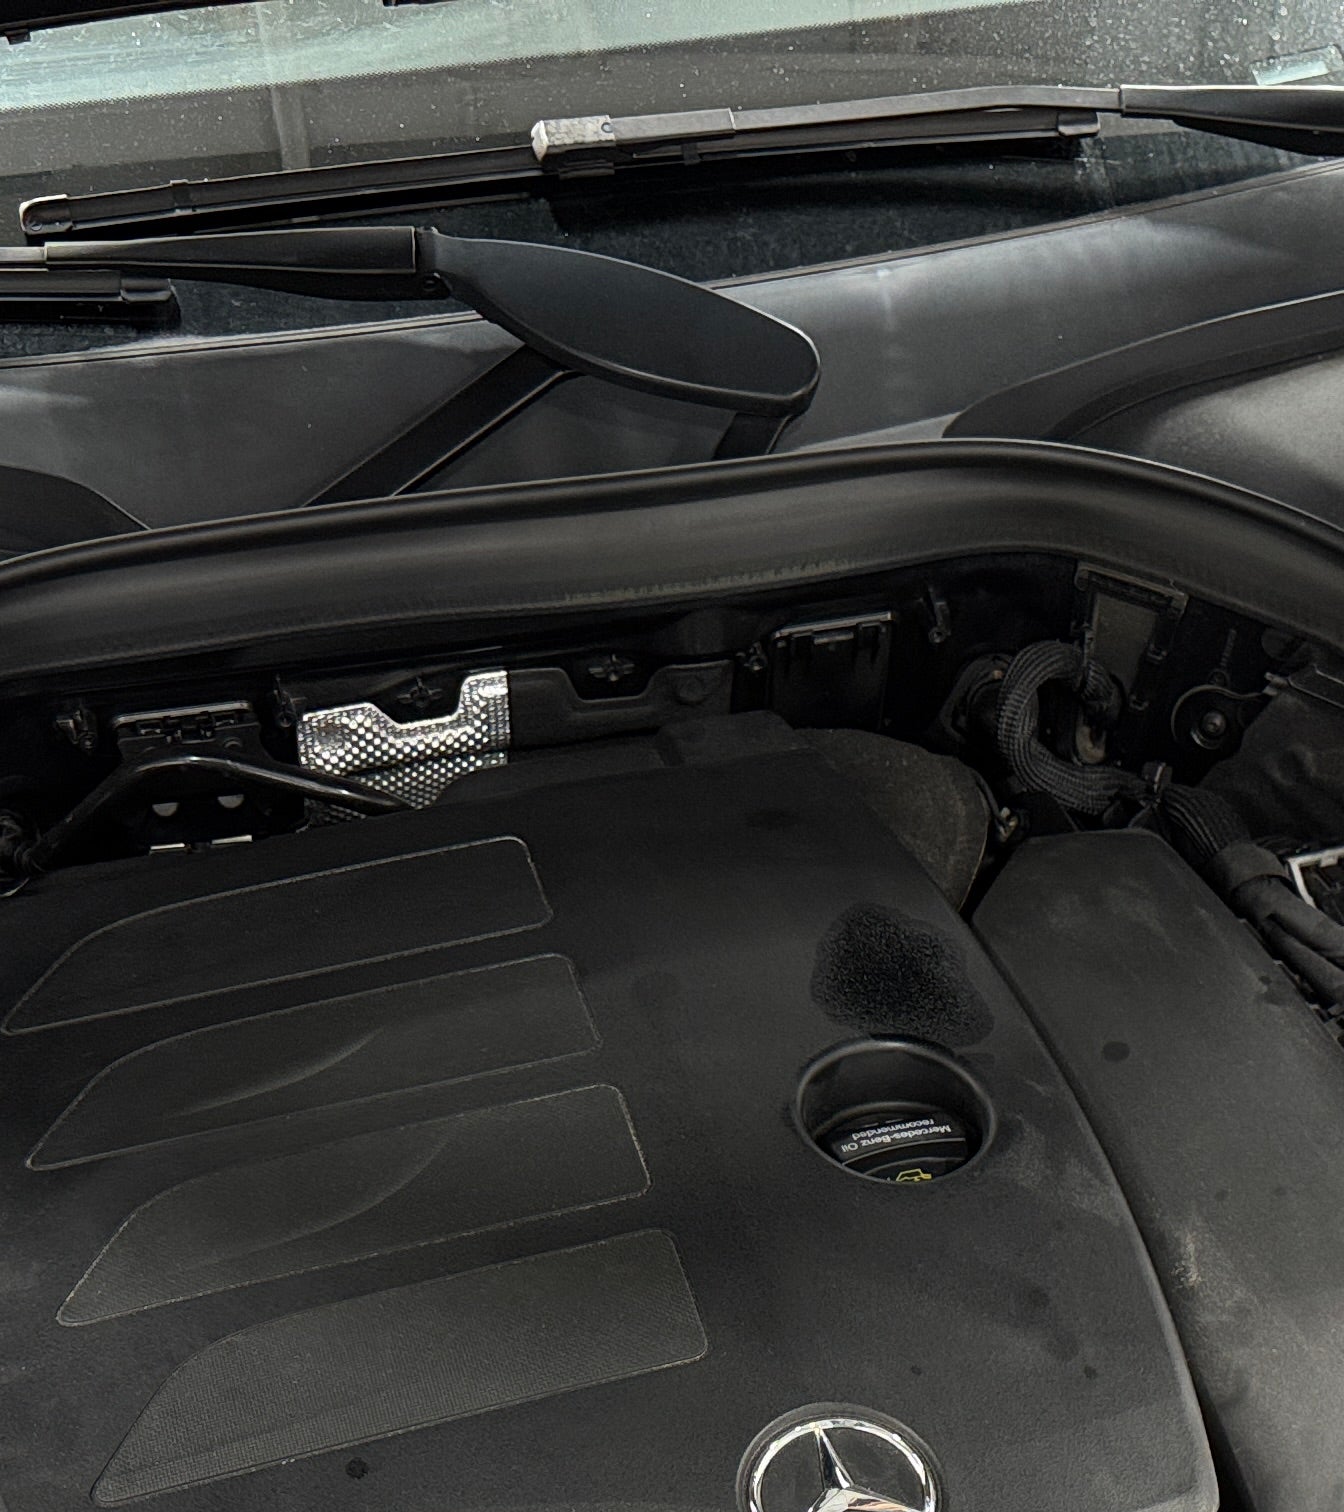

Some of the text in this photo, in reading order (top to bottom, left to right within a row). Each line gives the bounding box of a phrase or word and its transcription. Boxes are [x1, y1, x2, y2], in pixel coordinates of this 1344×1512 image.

[841, 1125, 951, 1152] Mercedes-Benz Oil
[851, 1118, 934, 1140] recommended
